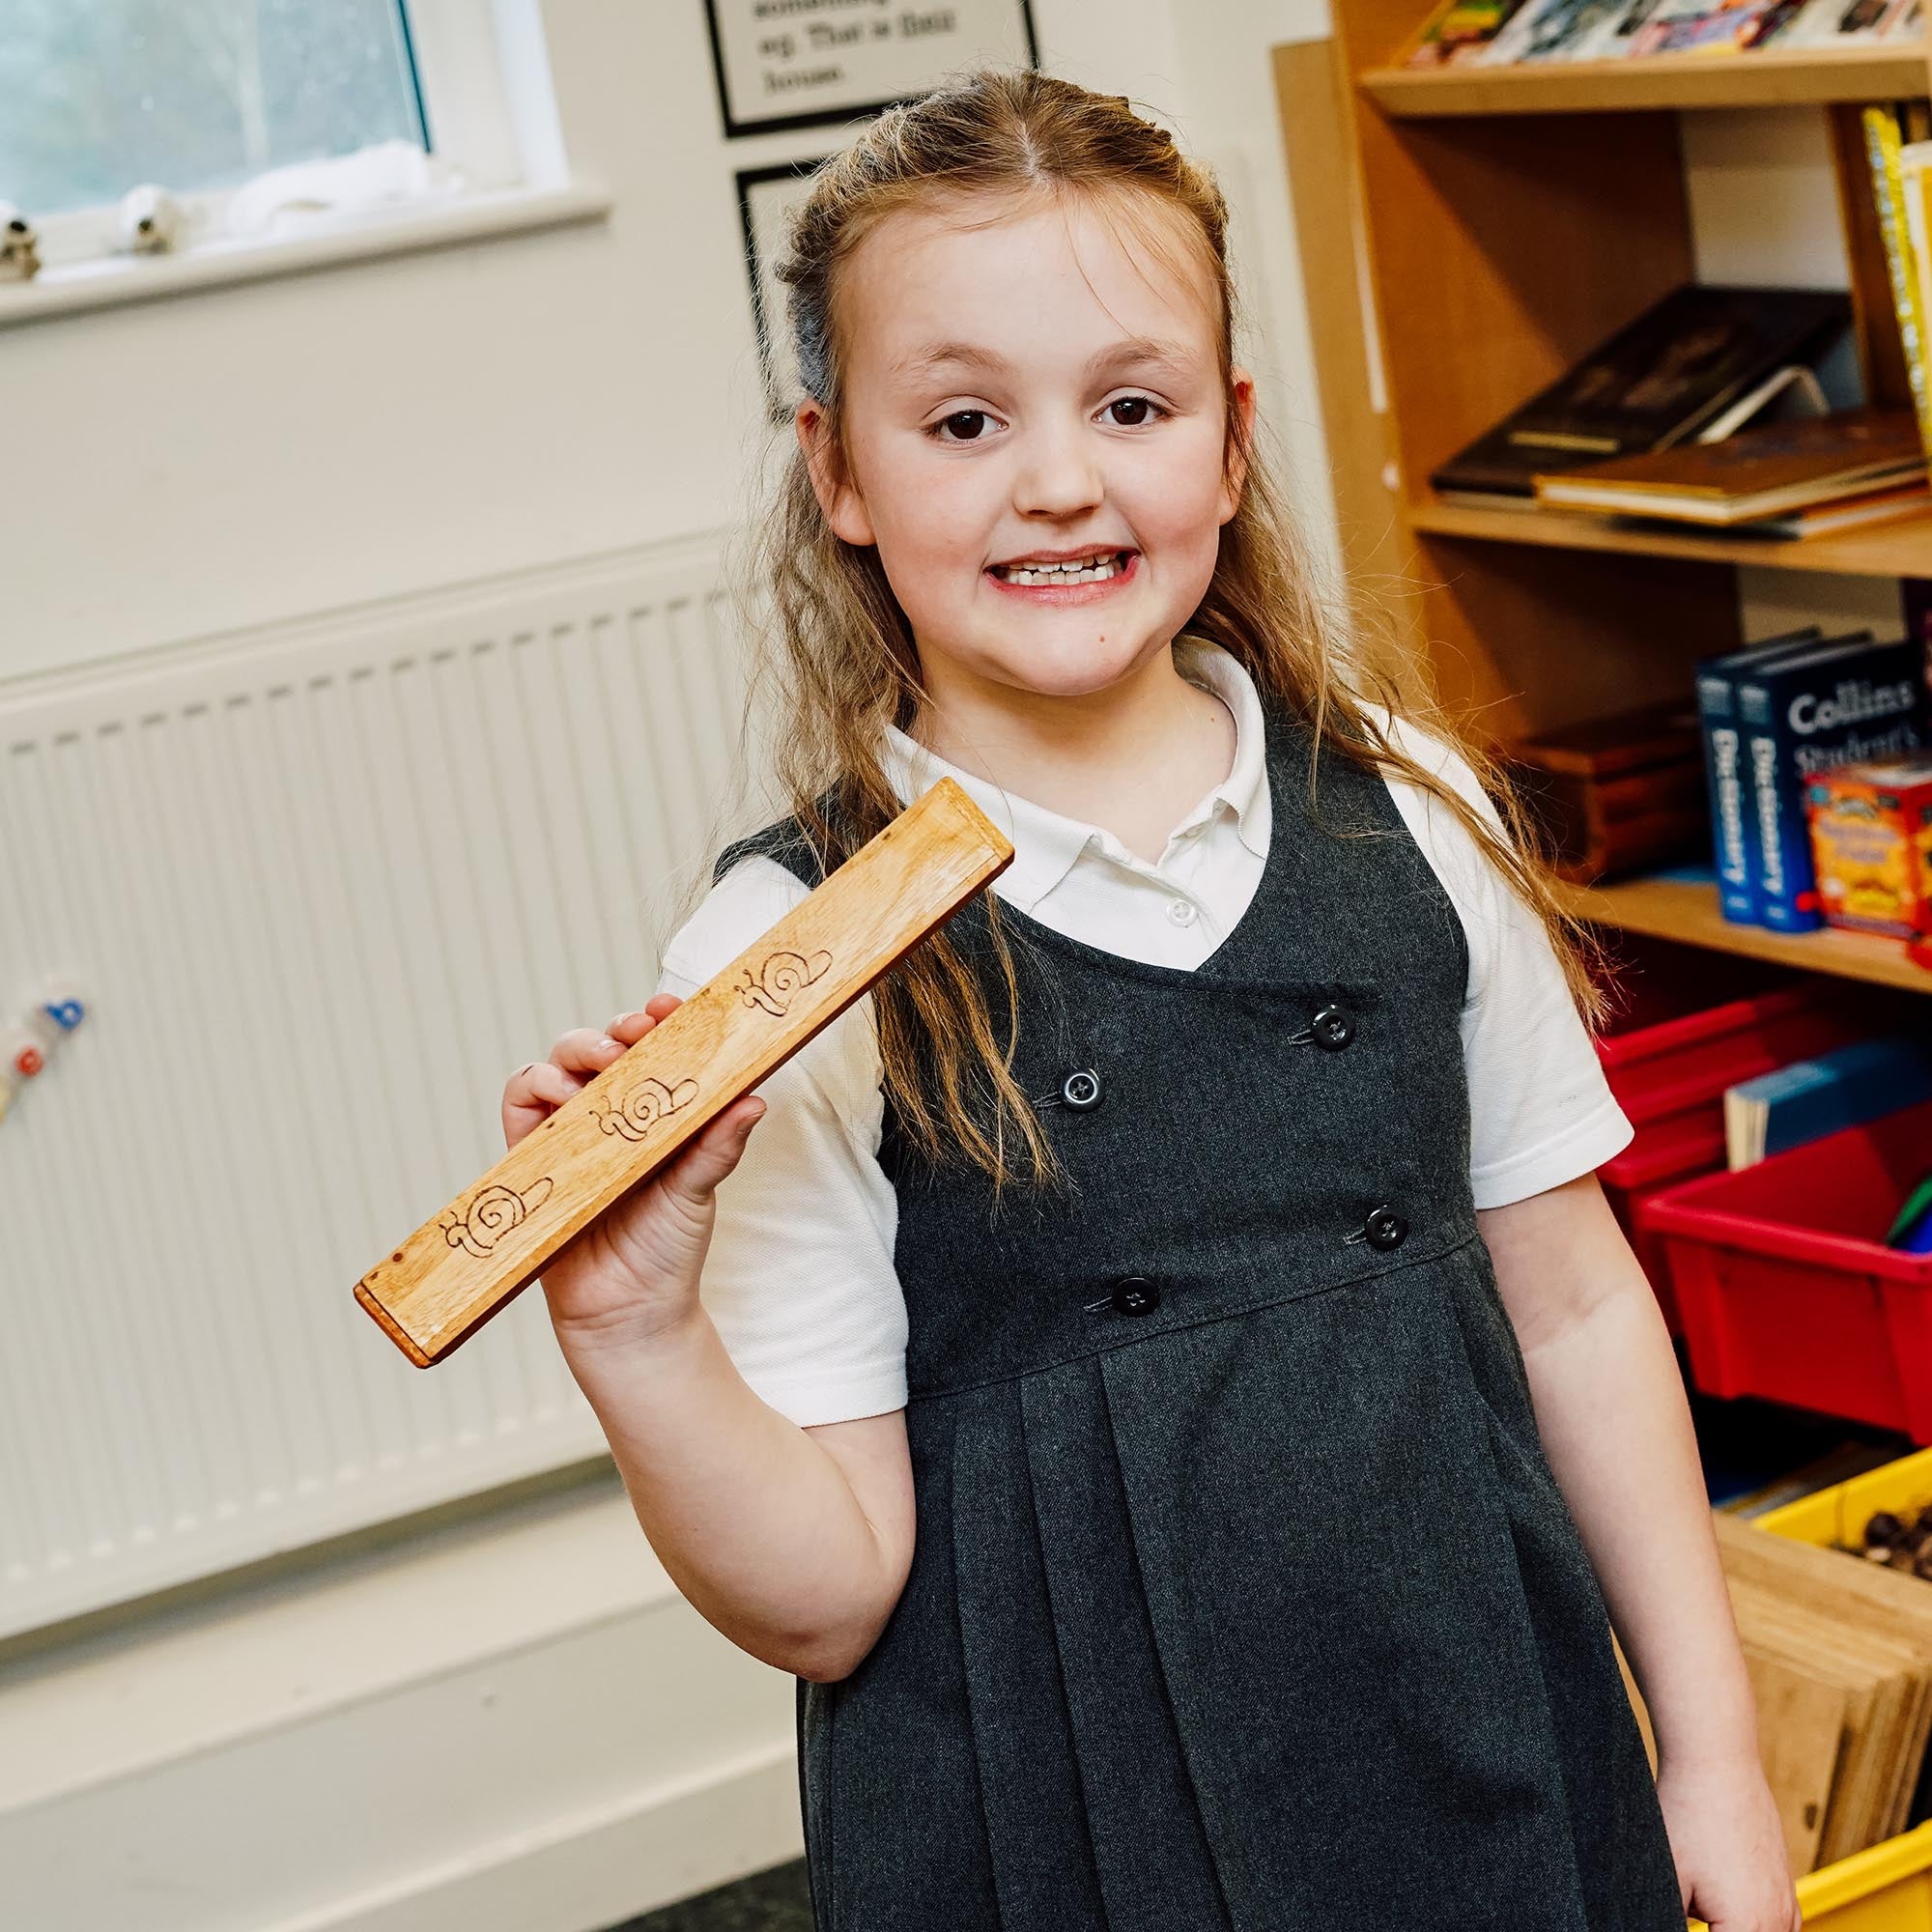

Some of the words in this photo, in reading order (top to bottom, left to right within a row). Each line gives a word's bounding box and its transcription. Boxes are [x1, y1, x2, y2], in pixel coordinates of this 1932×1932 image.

[807, 22, 864, 48] That
[1789, 680, 1914, 733] Collins
[1713, 730, 1746, 885] Dictionary
[1751, 738, 1783, 895] Dictionary
